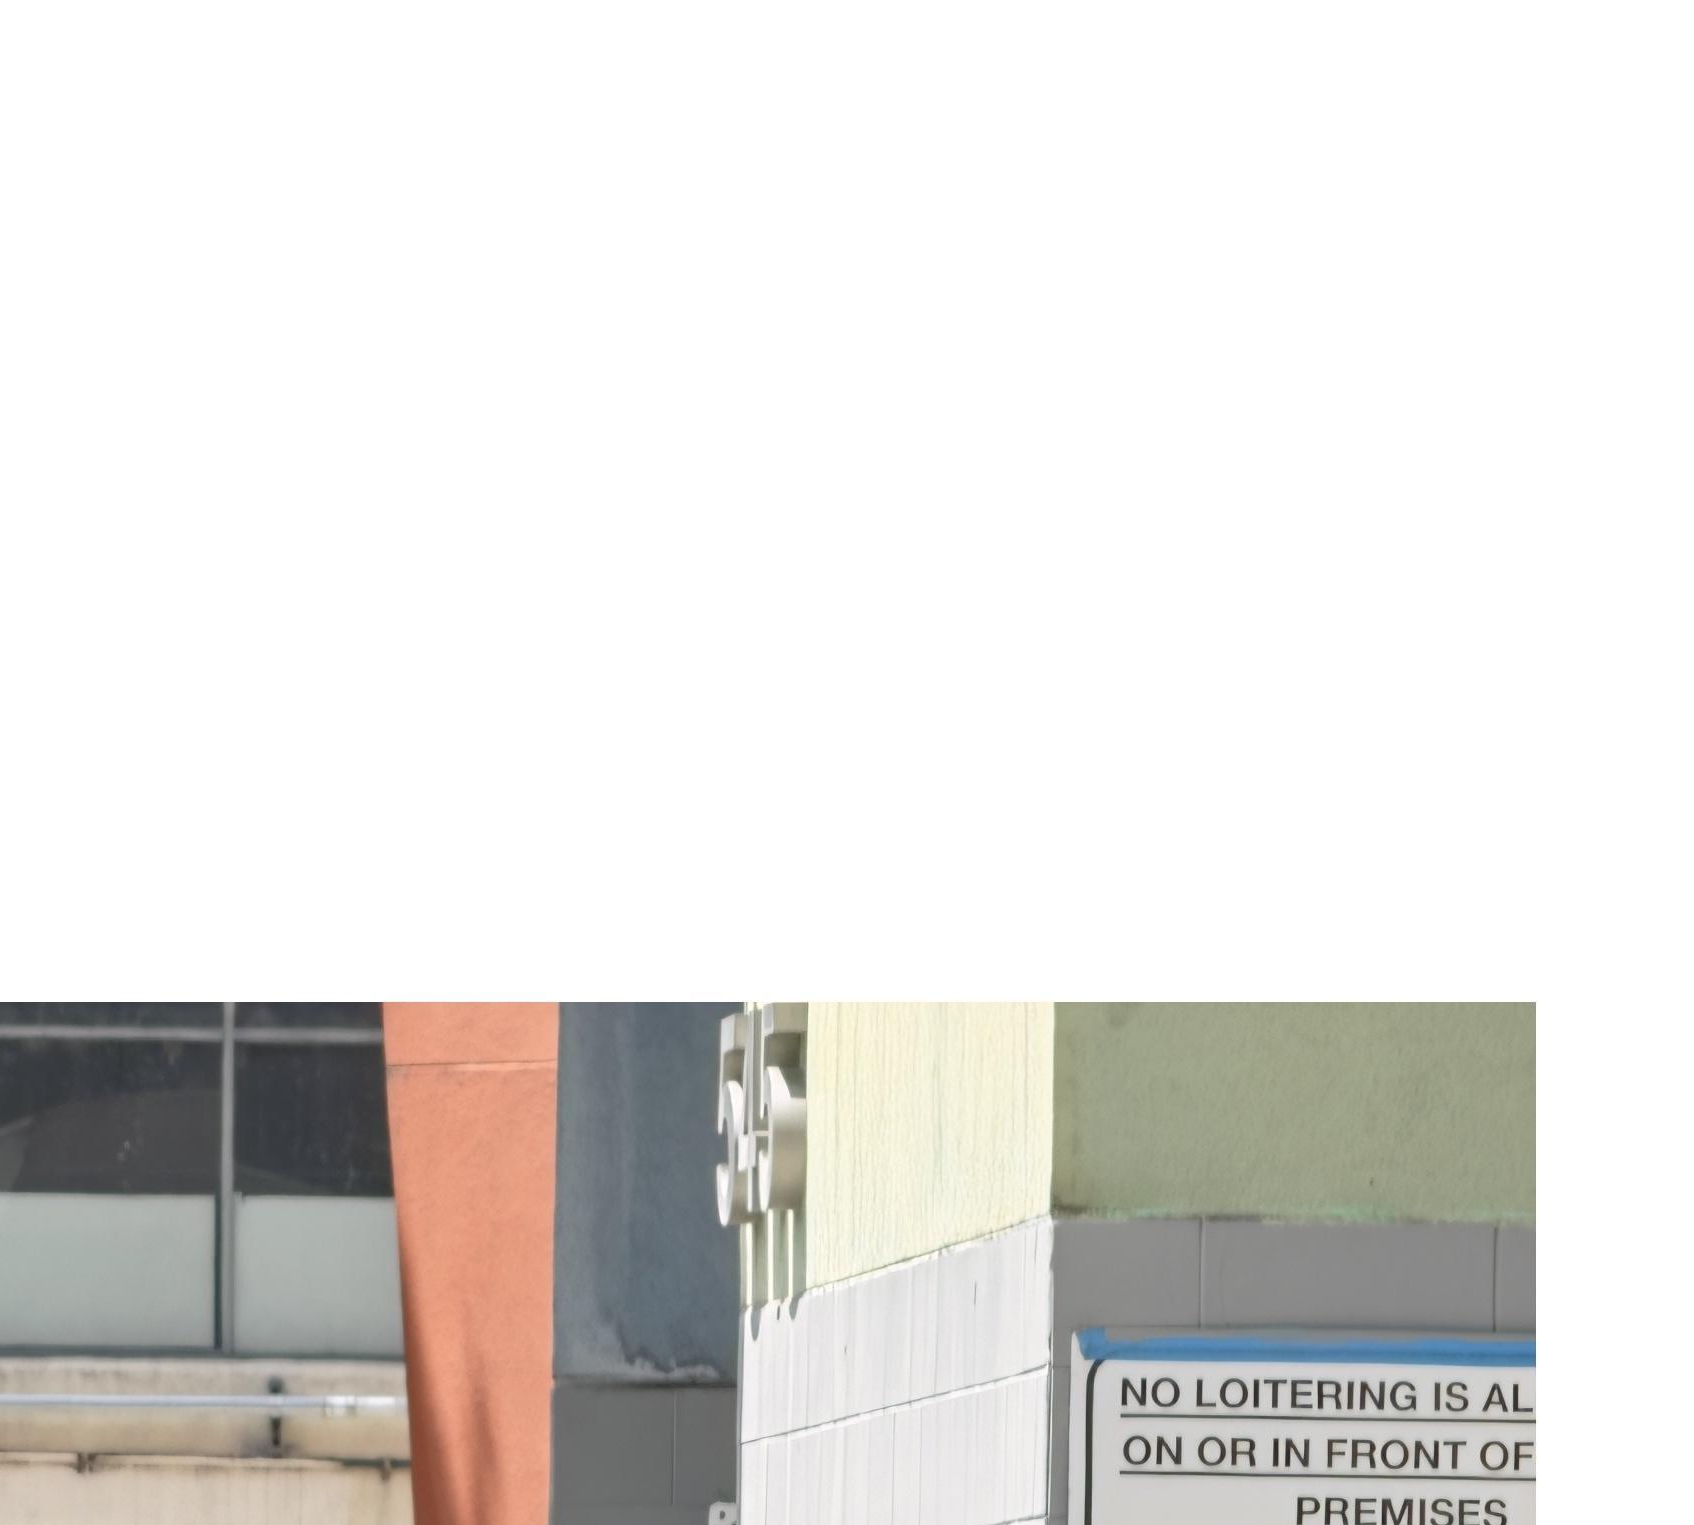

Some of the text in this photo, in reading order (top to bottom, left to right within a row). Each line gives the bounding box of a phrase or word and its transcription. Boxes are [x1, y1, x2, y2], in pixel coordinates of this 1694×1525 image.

[1120, 1377, 1535, 1412] NO LOITERING IS AL
[1122, 1435, 1535, 1471] ON OR IN FRONT OF
